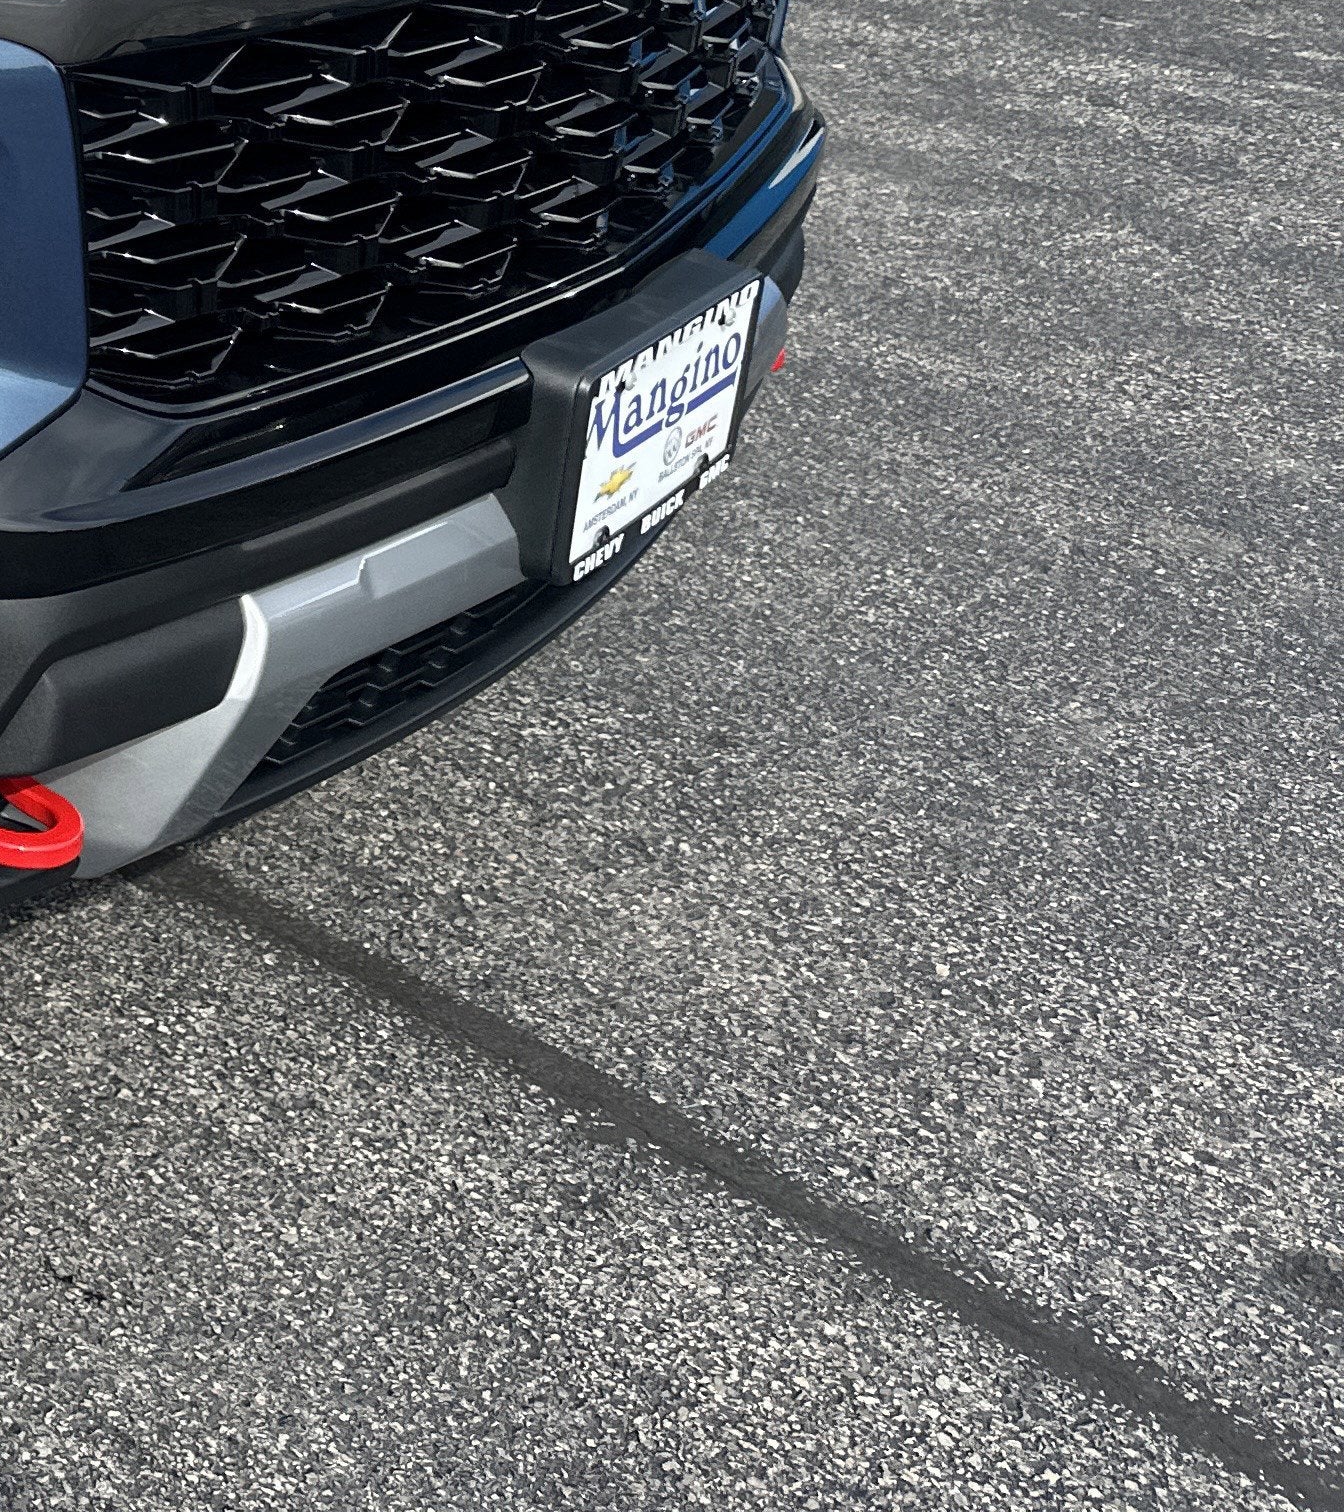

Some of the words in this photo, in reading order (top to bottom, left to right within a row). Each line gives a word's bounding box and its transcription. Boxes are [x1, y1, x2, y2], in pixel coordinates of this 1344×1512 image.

[586, 332, 742, 458] Mangino
[597, 279, 760, 398] MANGINO
[685, 414, 718, 448] GMC
[573, 533, 625, 582] CHEVY
[640, 489, 686, 535] BUICK
[698, 453, 731, 490] GMC
